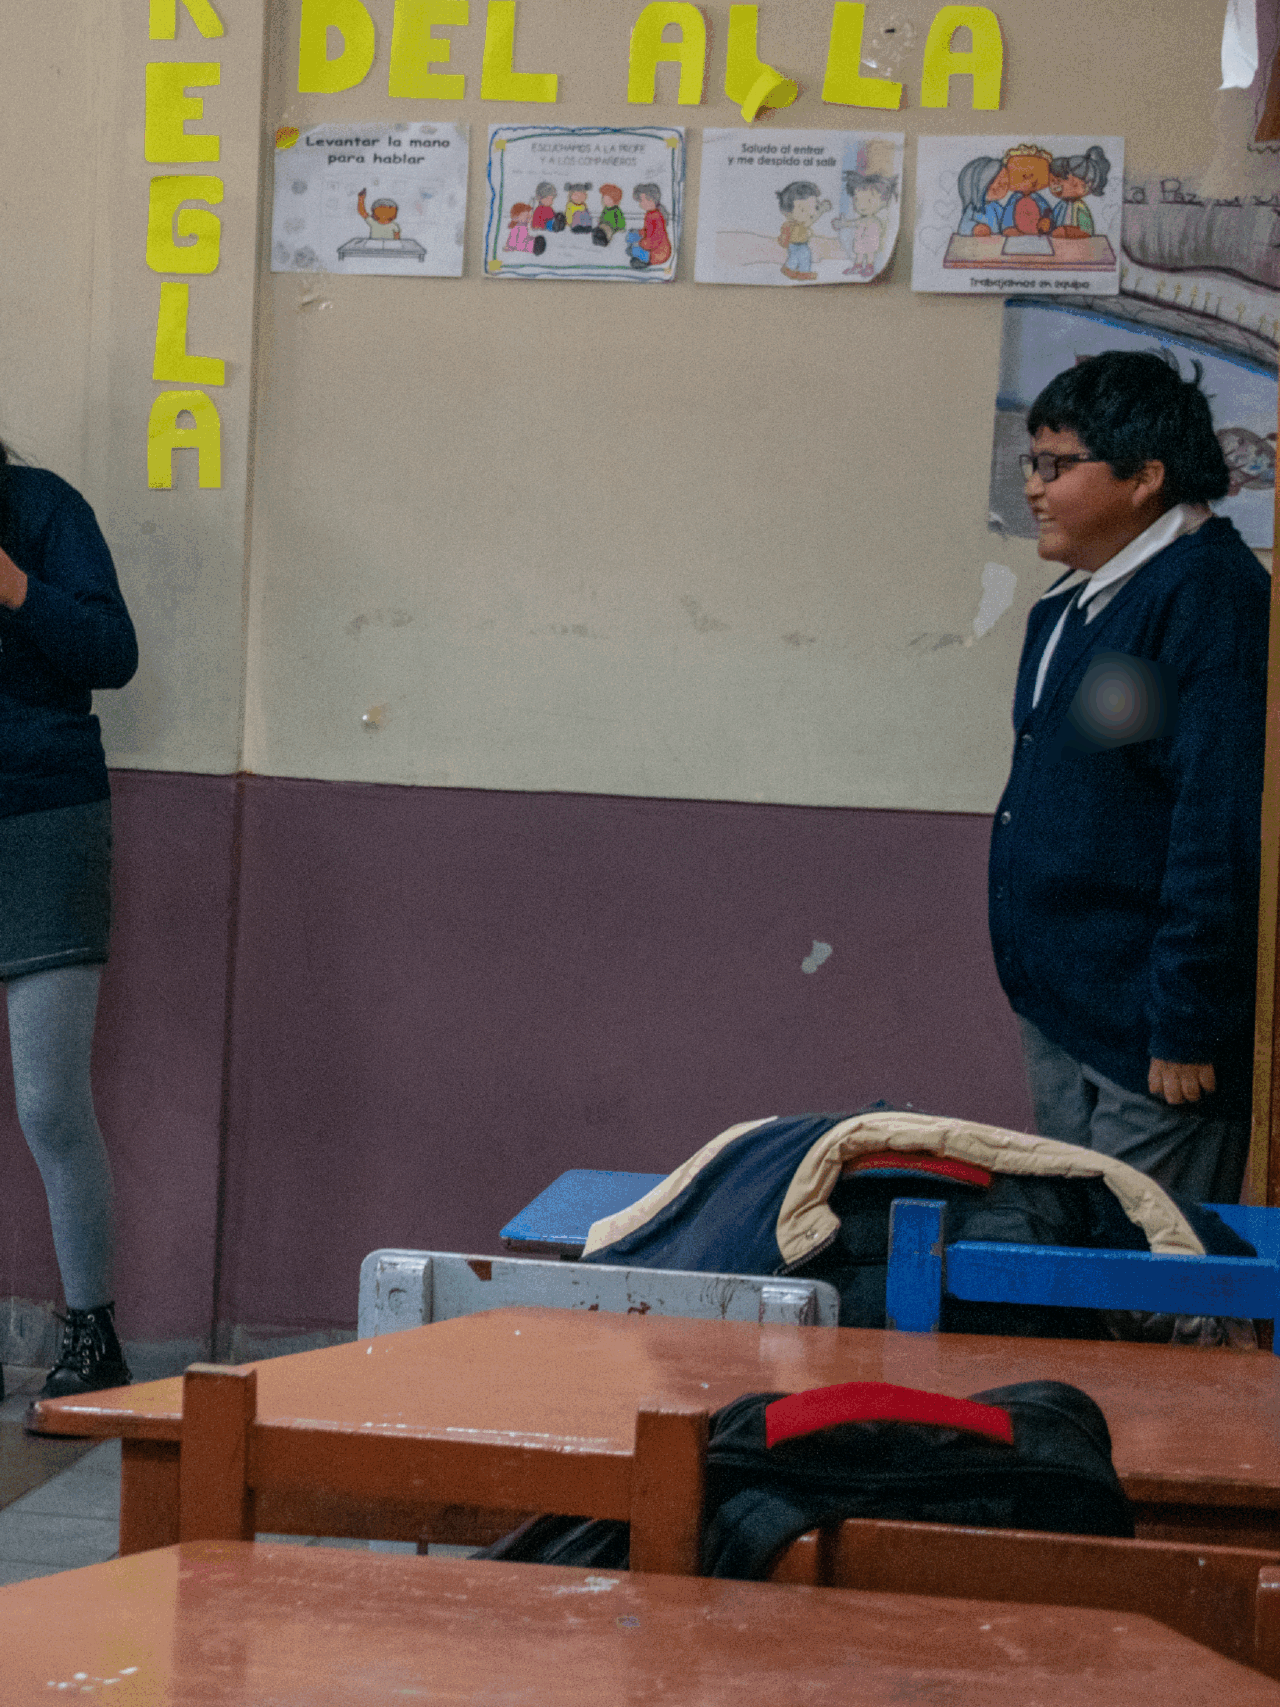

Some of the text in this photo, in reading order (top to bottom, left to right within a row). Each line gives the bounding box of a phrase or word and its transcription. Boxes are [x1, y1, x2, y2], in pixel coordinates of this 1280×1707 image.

[297, 0, 559, 103] DEL
[305, 136, 451, 148] Levantar la mano
[531, 143, 591, 154] ESCUCHAMOS
[593, 143, 601, 153] A
[604, 143, 616, 154] LA
[741, 143, 825, 155] Saludo al entrar
[327, 153, 425, 165] para hablar
[539, 155, 547, 165] Y
[548, 155, 556, 165] A
[558, 155, 575, 166] LOS
[727, 156, 837, 167] y me despido al salir
[969, 277, 1090, 290] Trabajamos en equipo
